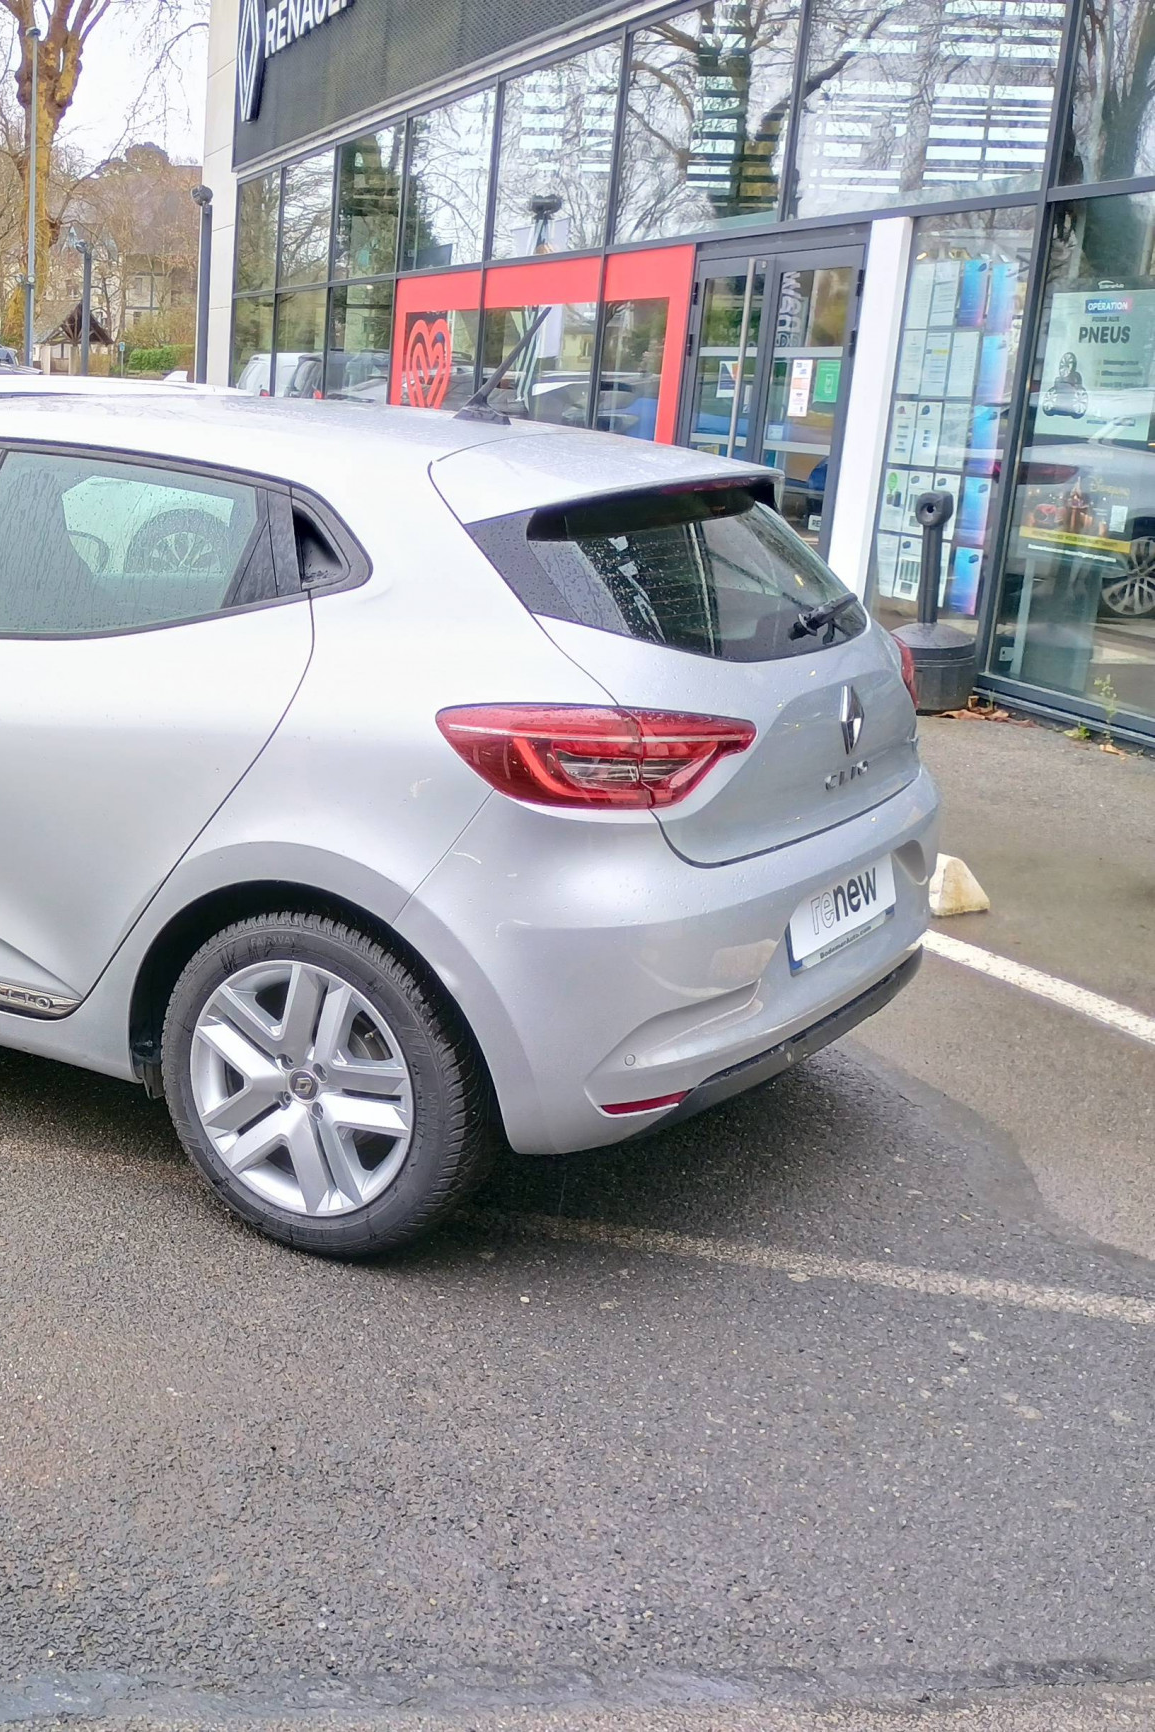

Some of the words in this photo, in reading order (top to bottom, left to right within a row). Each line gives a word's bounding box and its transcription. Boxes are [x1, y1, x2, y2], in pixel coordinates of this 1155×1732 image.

[1087, 300, 1128, 311] OPÉRATION
[1078, 326, 1131, 343] PNEUS
[811, 867, 877, 935] renew
